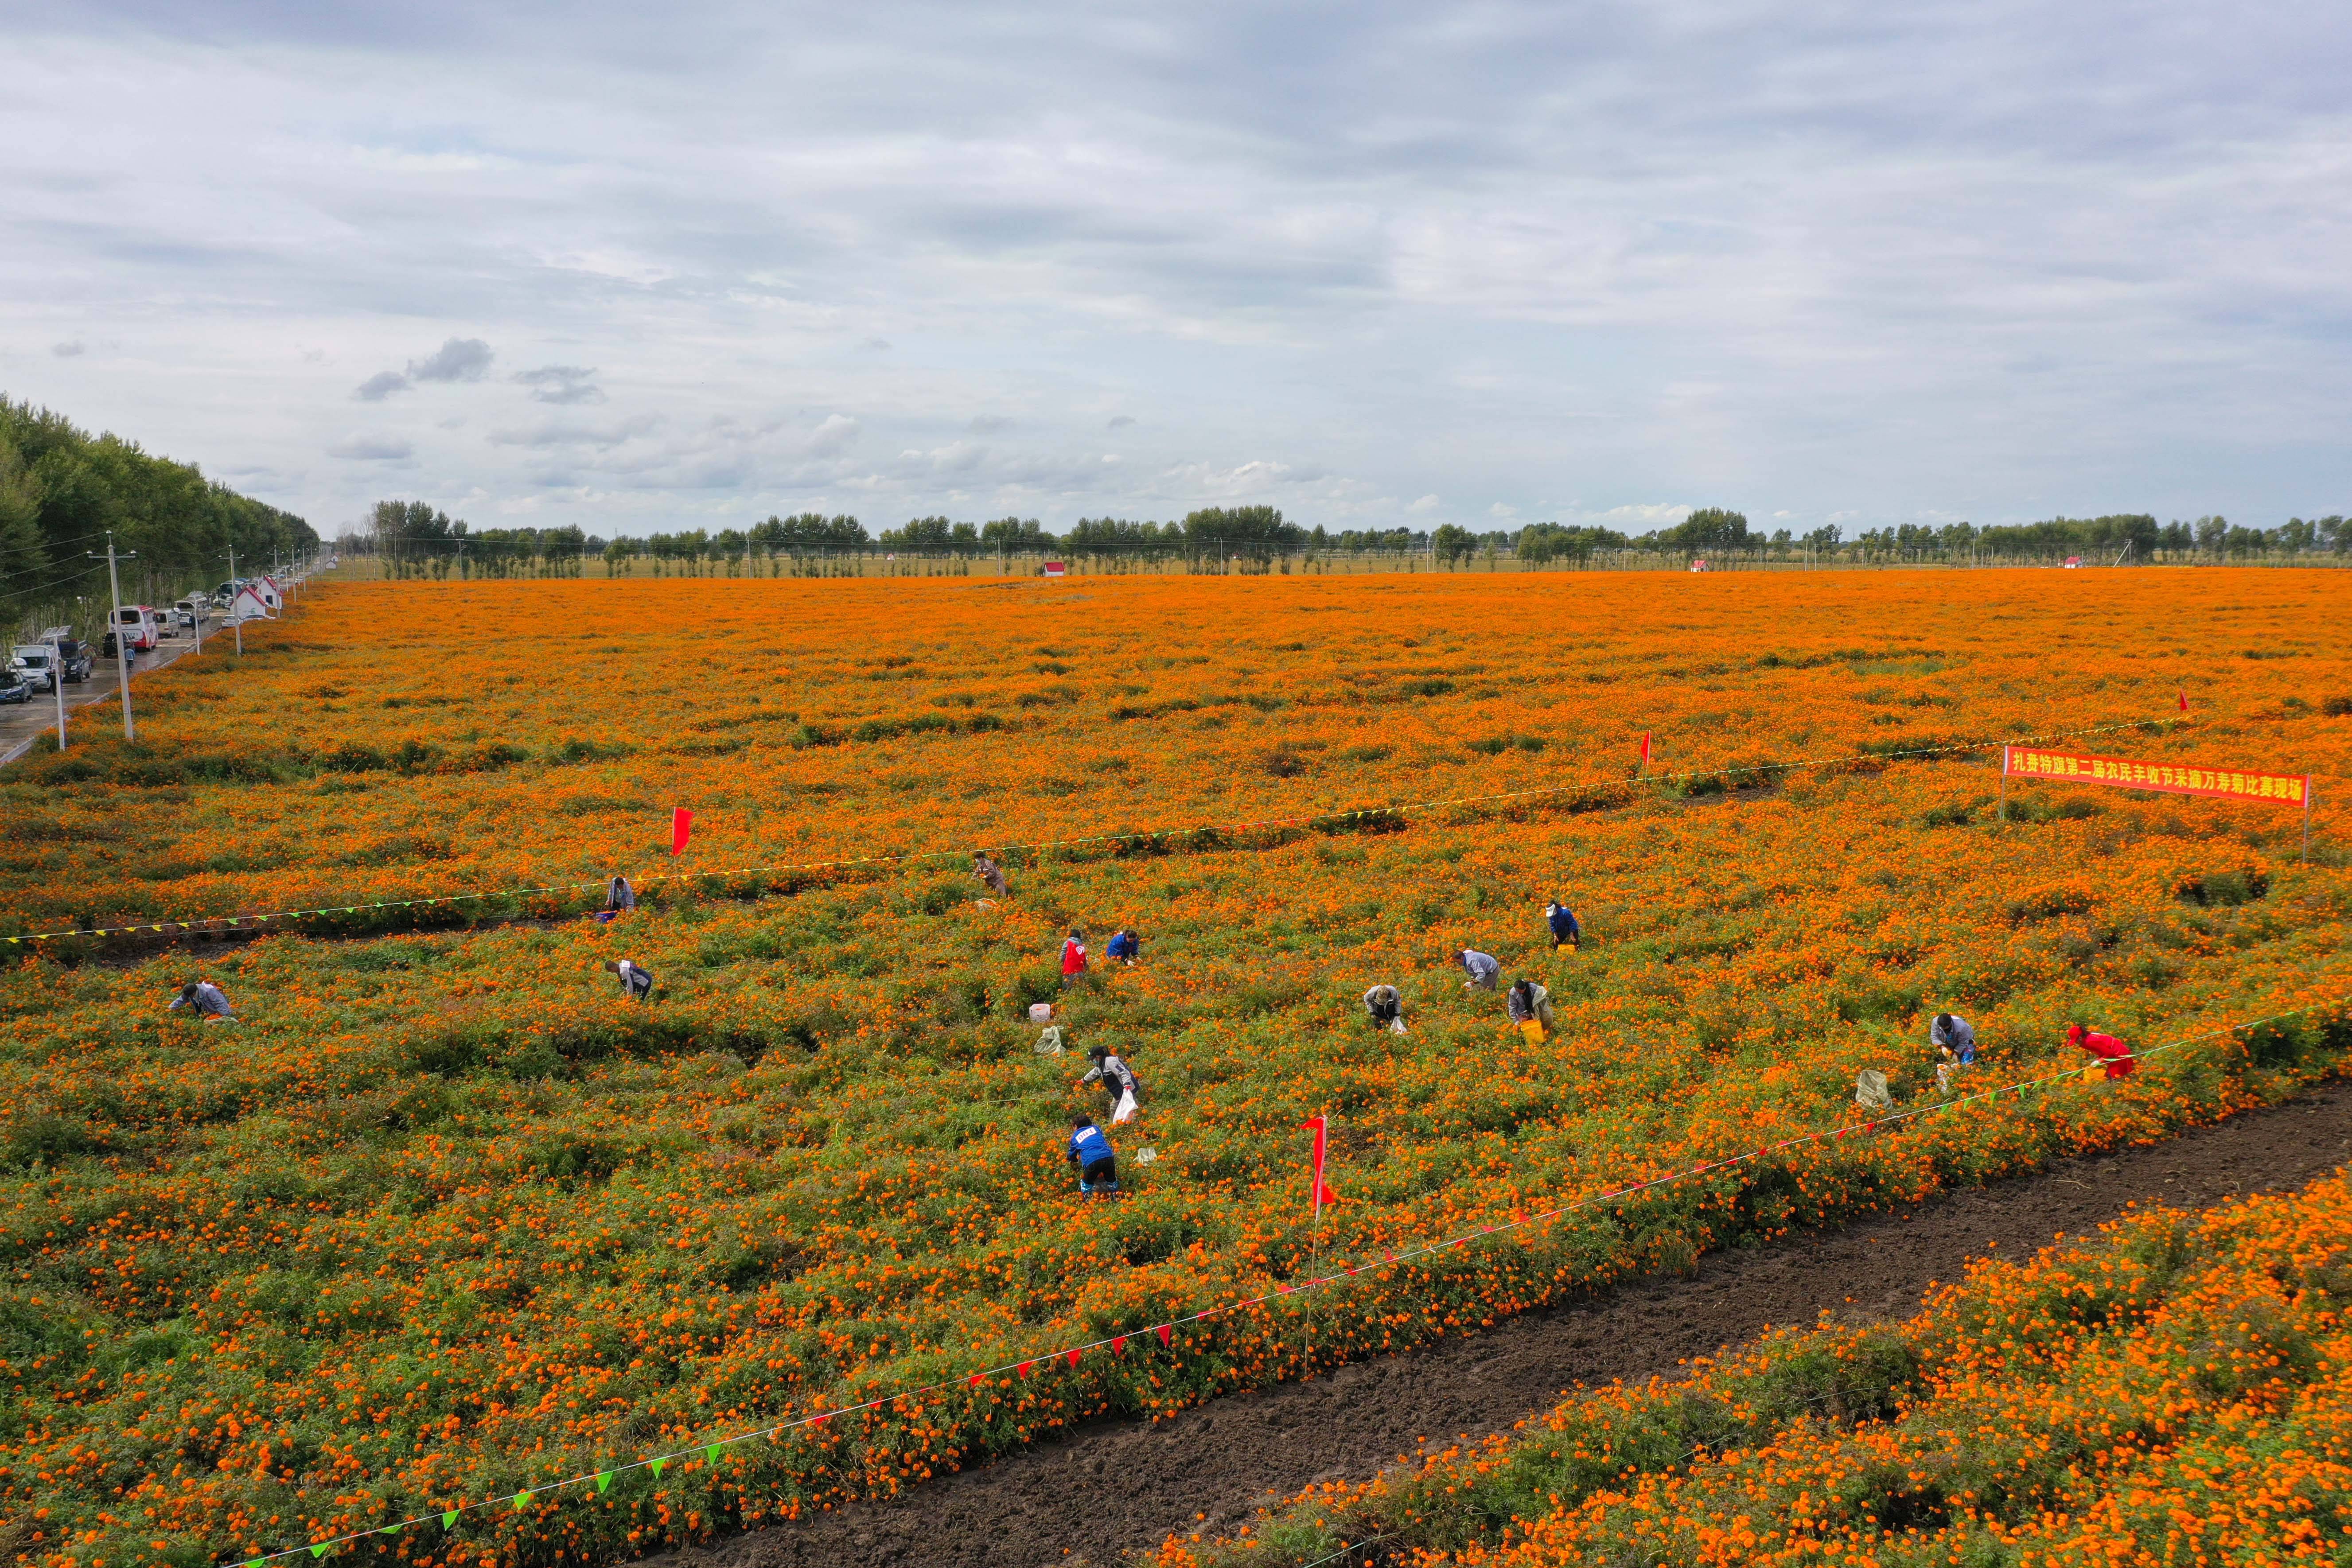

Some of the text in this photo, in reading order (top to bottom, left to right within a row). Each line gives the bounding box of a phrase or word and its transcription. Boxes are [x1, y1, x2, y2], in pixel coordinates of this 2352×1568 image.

[2013, 751, 2302, 801] 扎赉特旗第二届农民丰收节采摘万寿菊比赛现场
